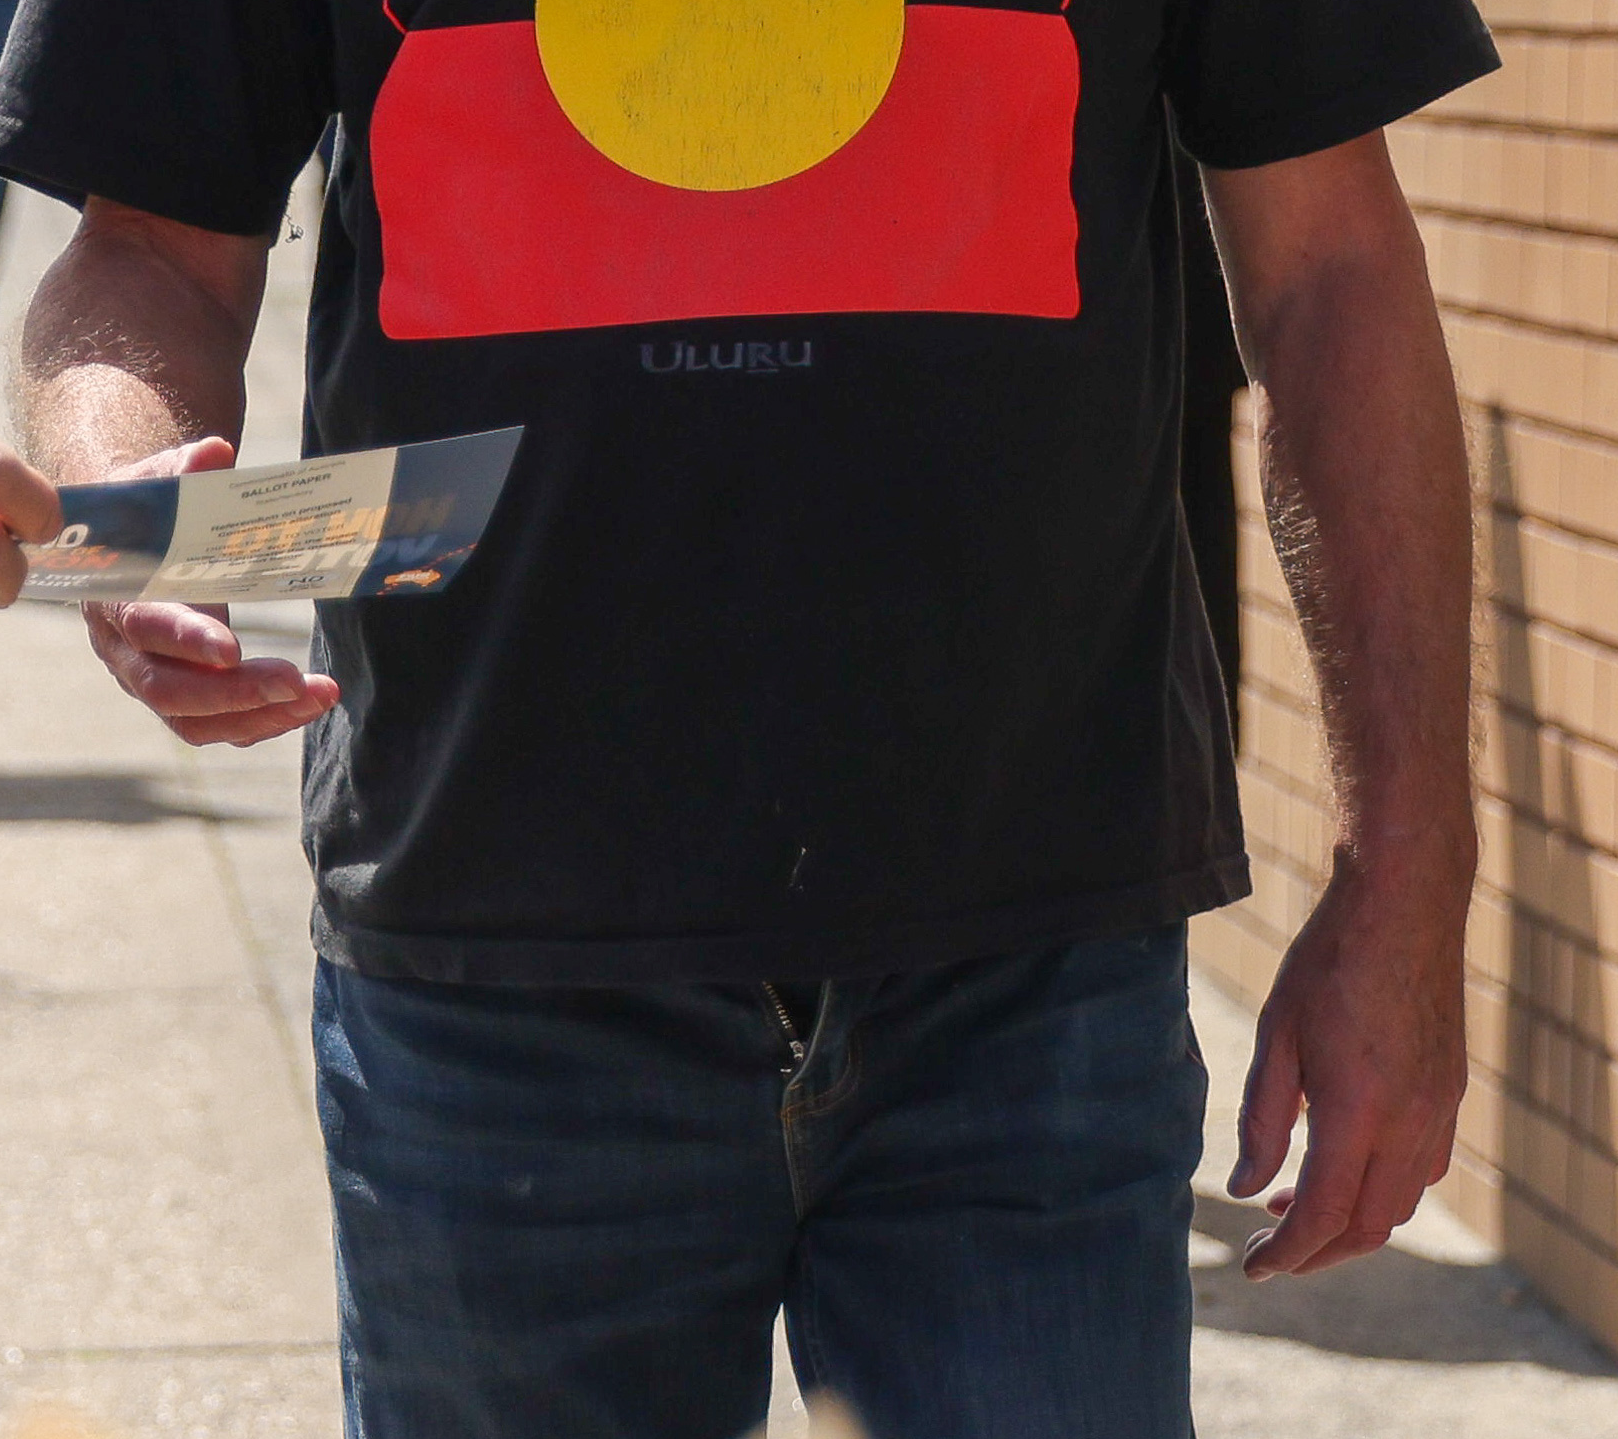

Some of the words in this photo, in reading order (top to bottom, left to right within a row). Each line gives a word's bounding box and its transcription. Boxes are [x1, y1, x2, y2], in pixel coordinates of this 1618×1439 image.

[241, 482, 289, 499] BALLOT
[291, 472, 332, 487] PAPER
[210, 513, 279, 532] Referendum
[281, 509, 296, 519] on
[298, 496, 353, 516] proposed
[288, 574, 325, 585] NO
